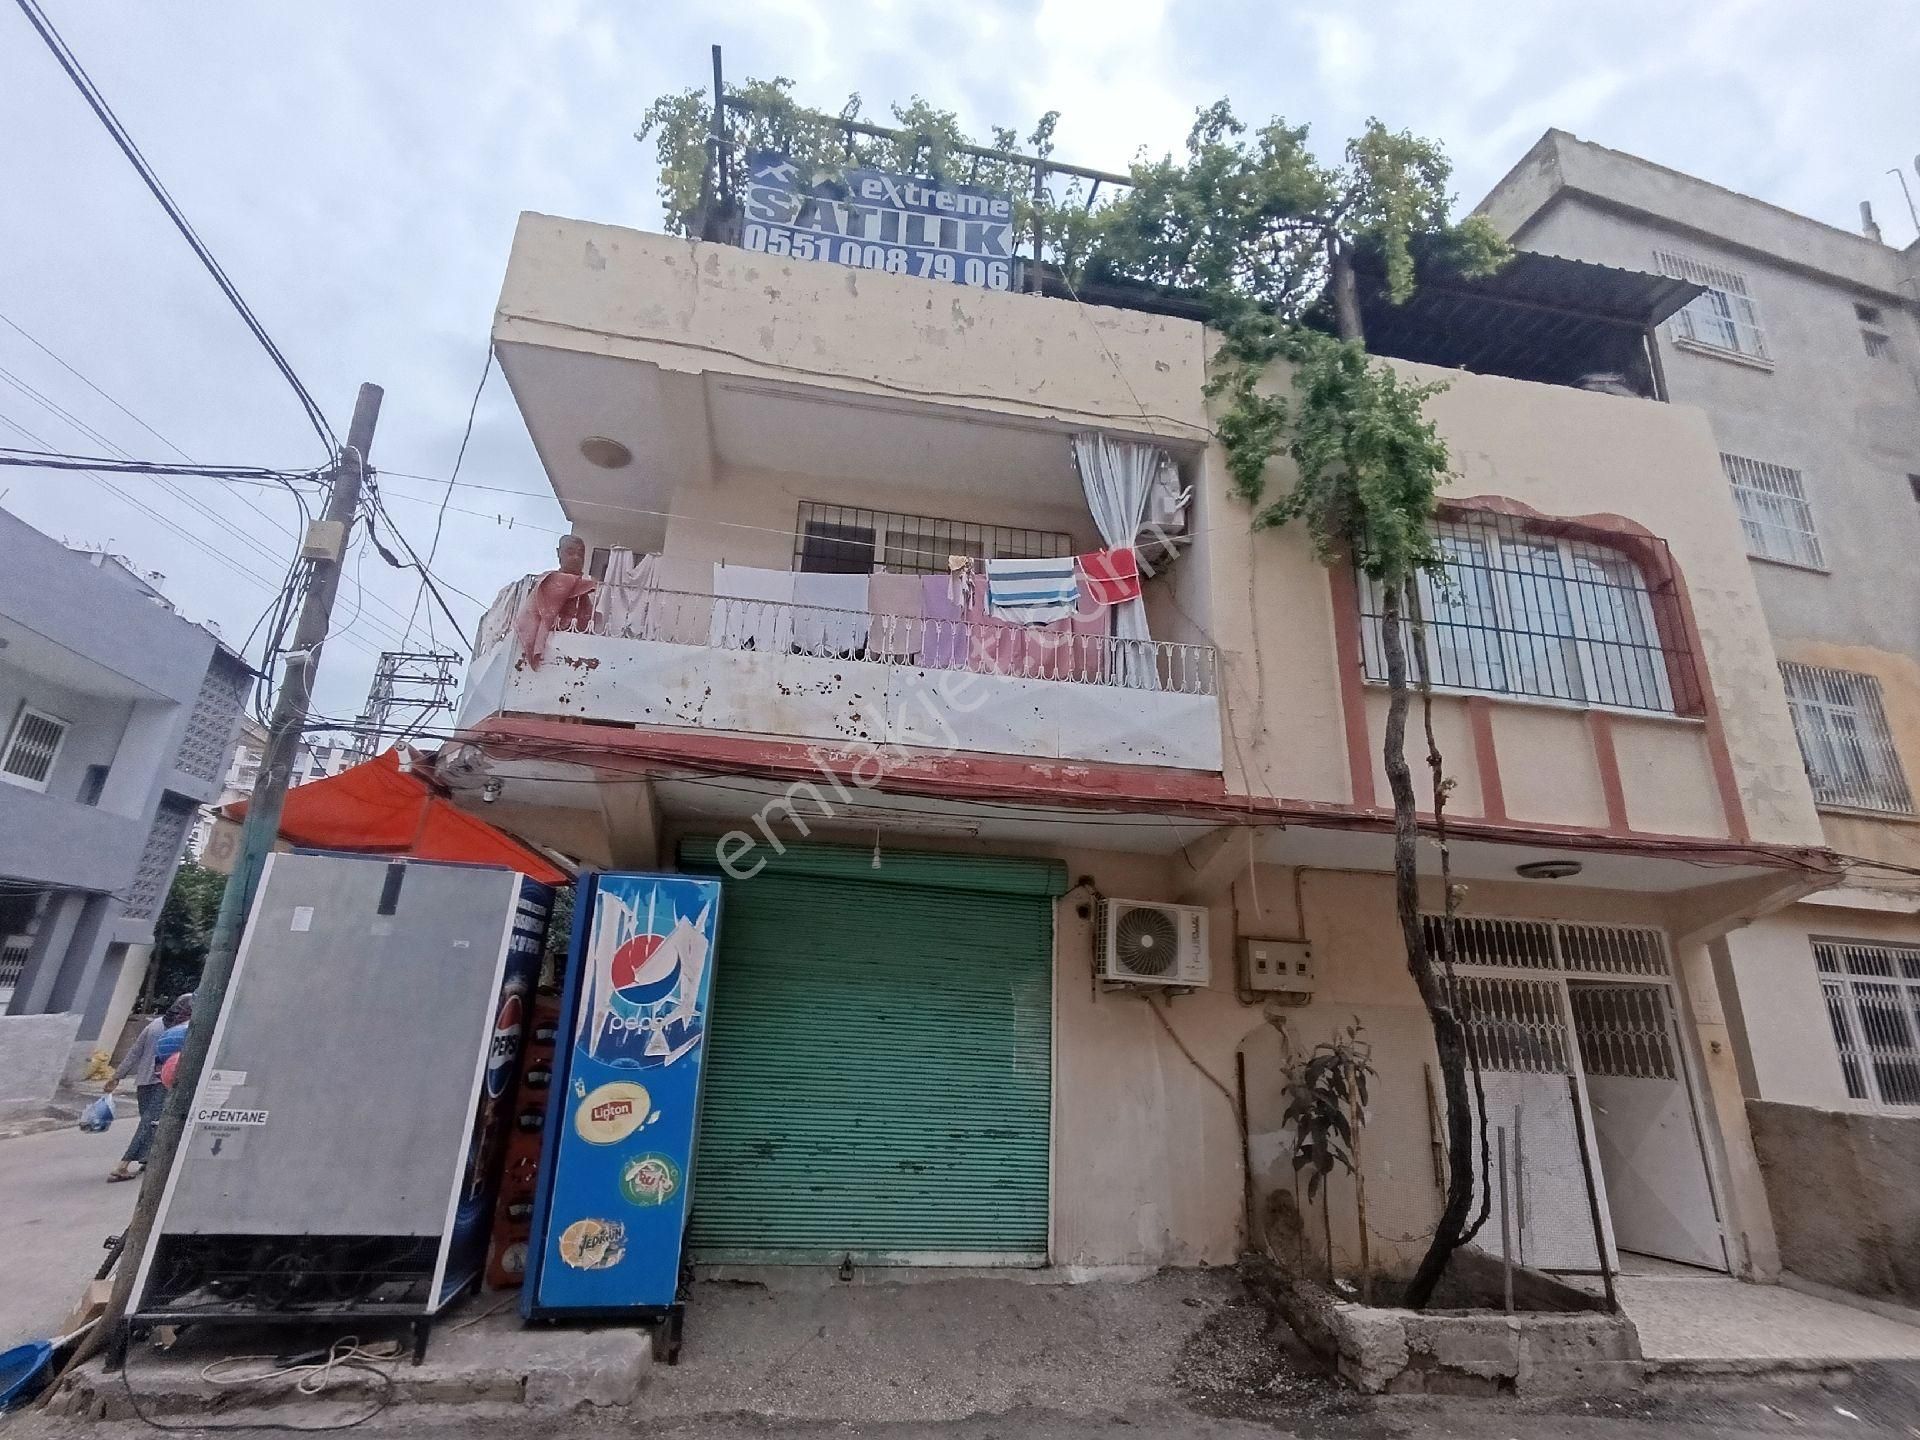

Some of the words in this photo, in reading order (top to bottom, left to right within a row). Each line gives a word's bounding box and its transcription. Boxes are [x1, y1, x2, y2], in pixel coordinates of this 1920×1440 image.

[743, 224, 831, 263] 0551
[838, 241, 908, 275] 008
[917, 252, 957, 283] 79
[964, 258, 1010, 291] 06
[198, 1110, 266, 1123] C-PENTANE
[593, 1103, 629, 1120] Lipton
